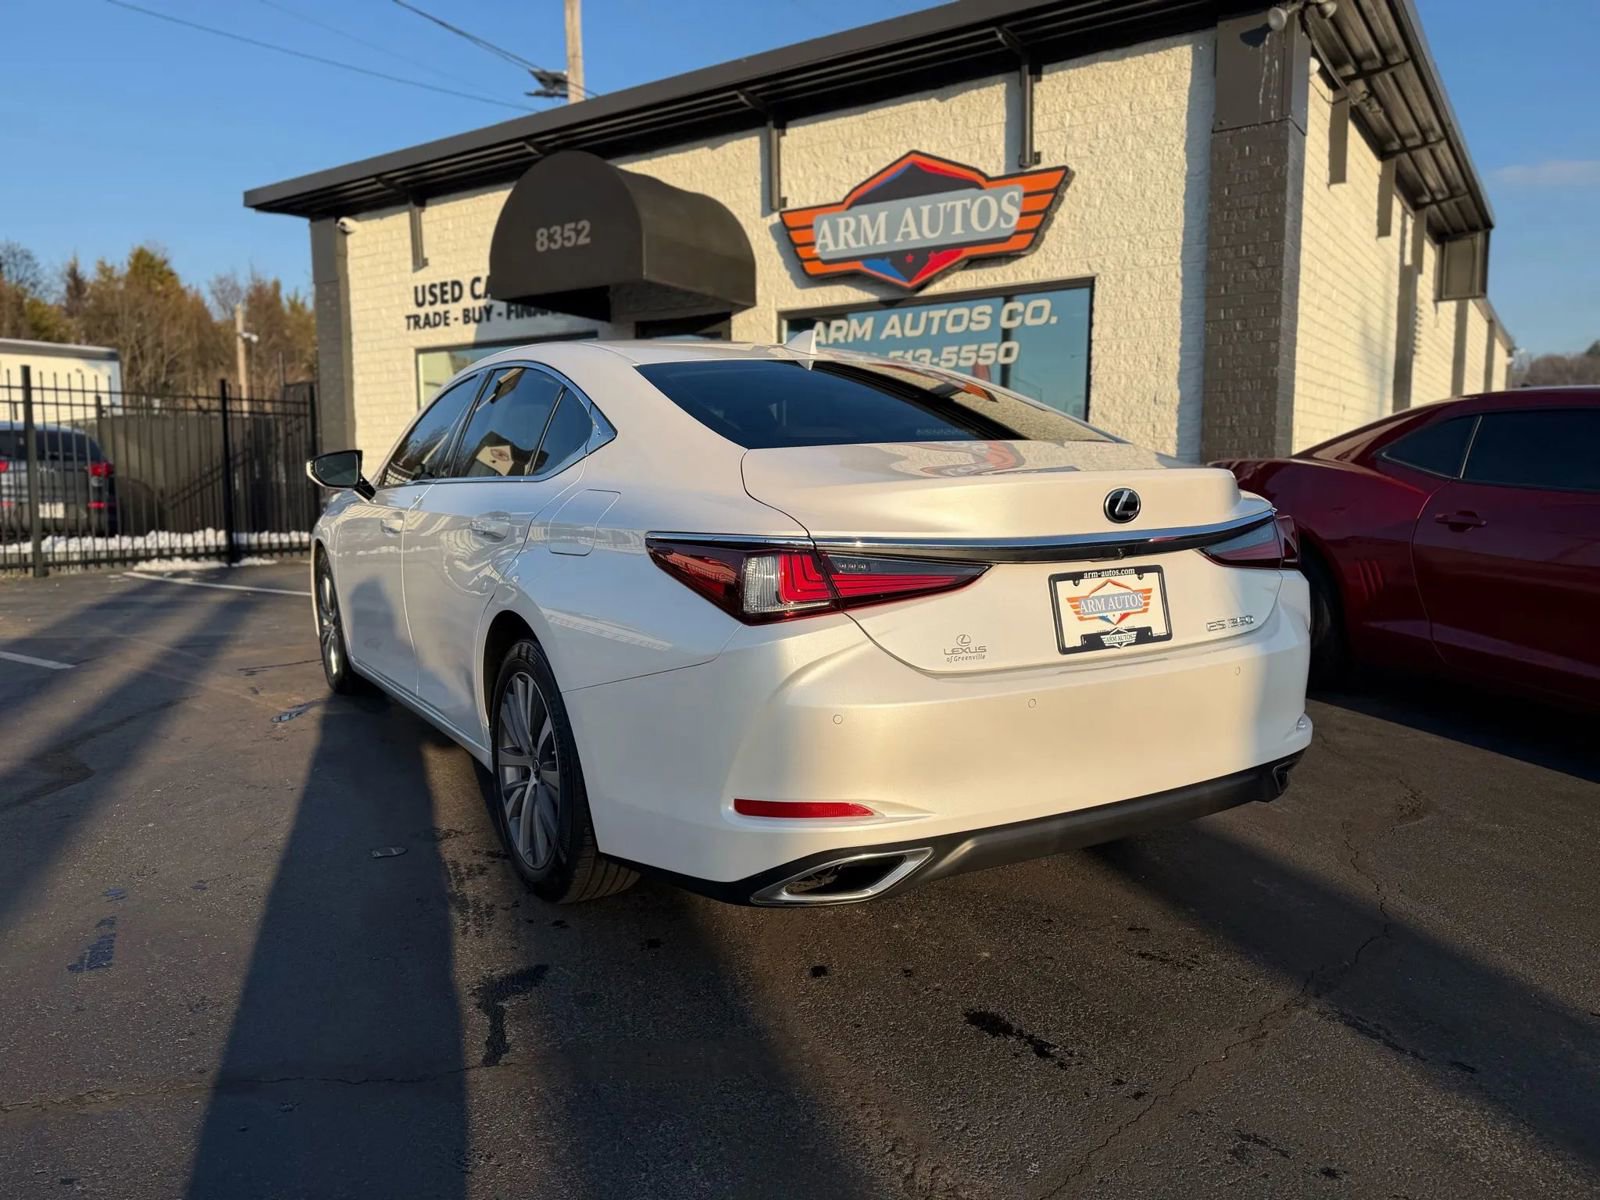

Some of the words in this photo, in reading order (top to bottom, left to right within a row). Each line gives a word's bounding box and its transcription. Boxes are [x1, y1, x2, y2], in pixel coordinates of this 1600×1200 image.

[535, 219, 592, 252] 8352
[813, 211, 889, 254] ARM
[894, 190, 1021, 243] AUTOS
[413, 279, 463, 308] USED
[405, 310, 451, 331] TRADE
[462, 303, 494, 325] BUY
[811, 316, 874, 345] ARM
[880, 304, 993, 341] AUTOS
[1001, 298, 1059, 330] CO.
[1083, 567, 1136, 580] arm-autos.com
[1080, 597, 1107, 614] ARM
[1107, 592, 1144, 611] AUTOS
[943, 645, 988, 656] LEXUS
